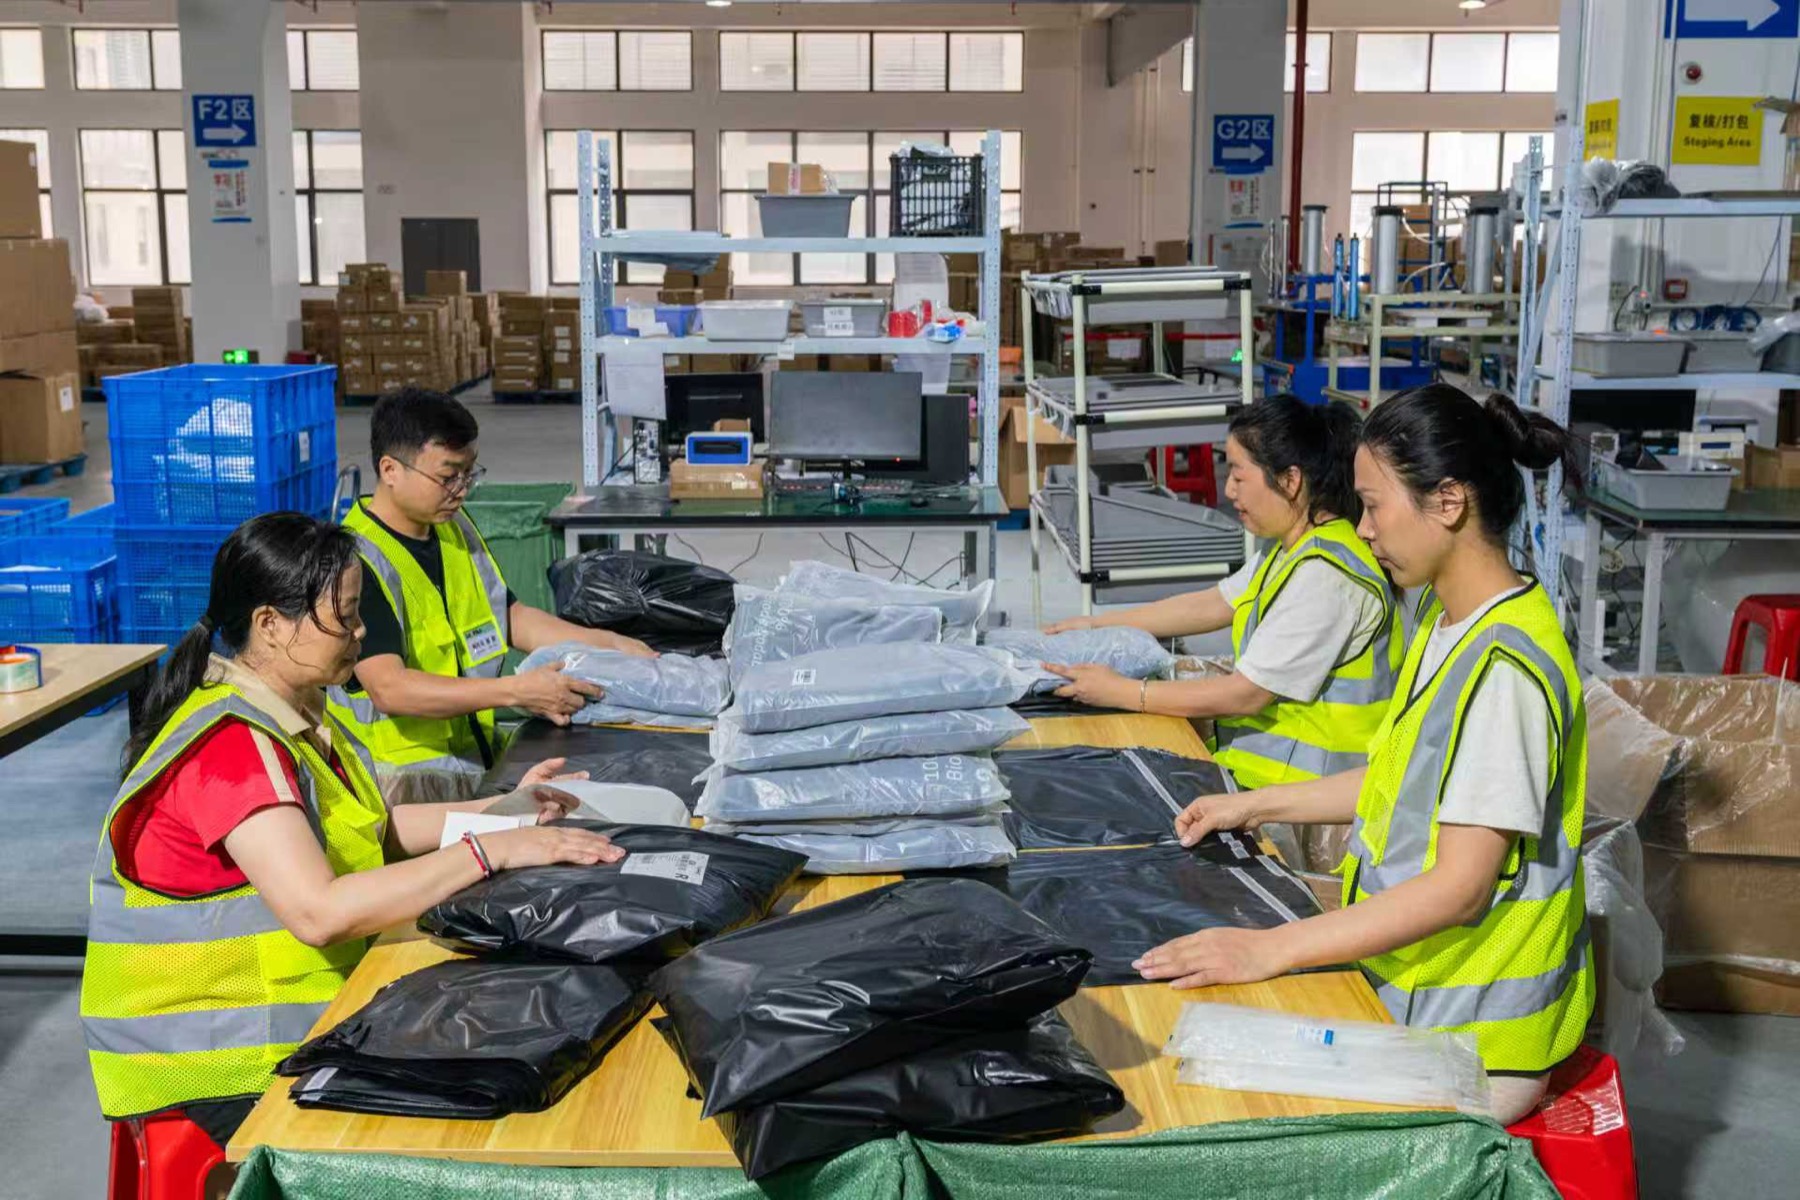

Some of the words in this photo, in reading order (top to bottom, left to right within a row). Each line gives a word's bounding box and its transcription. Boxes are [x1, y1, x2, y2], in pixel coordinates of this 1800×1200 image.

[198, 98, 252, 120] F2区
[1217, 120, 1271, 139] G2区
[1684, 136, 1724, 149] Staging
[1727, 137, 1751, 147] Area
[923, 756, 939, 781] 10
